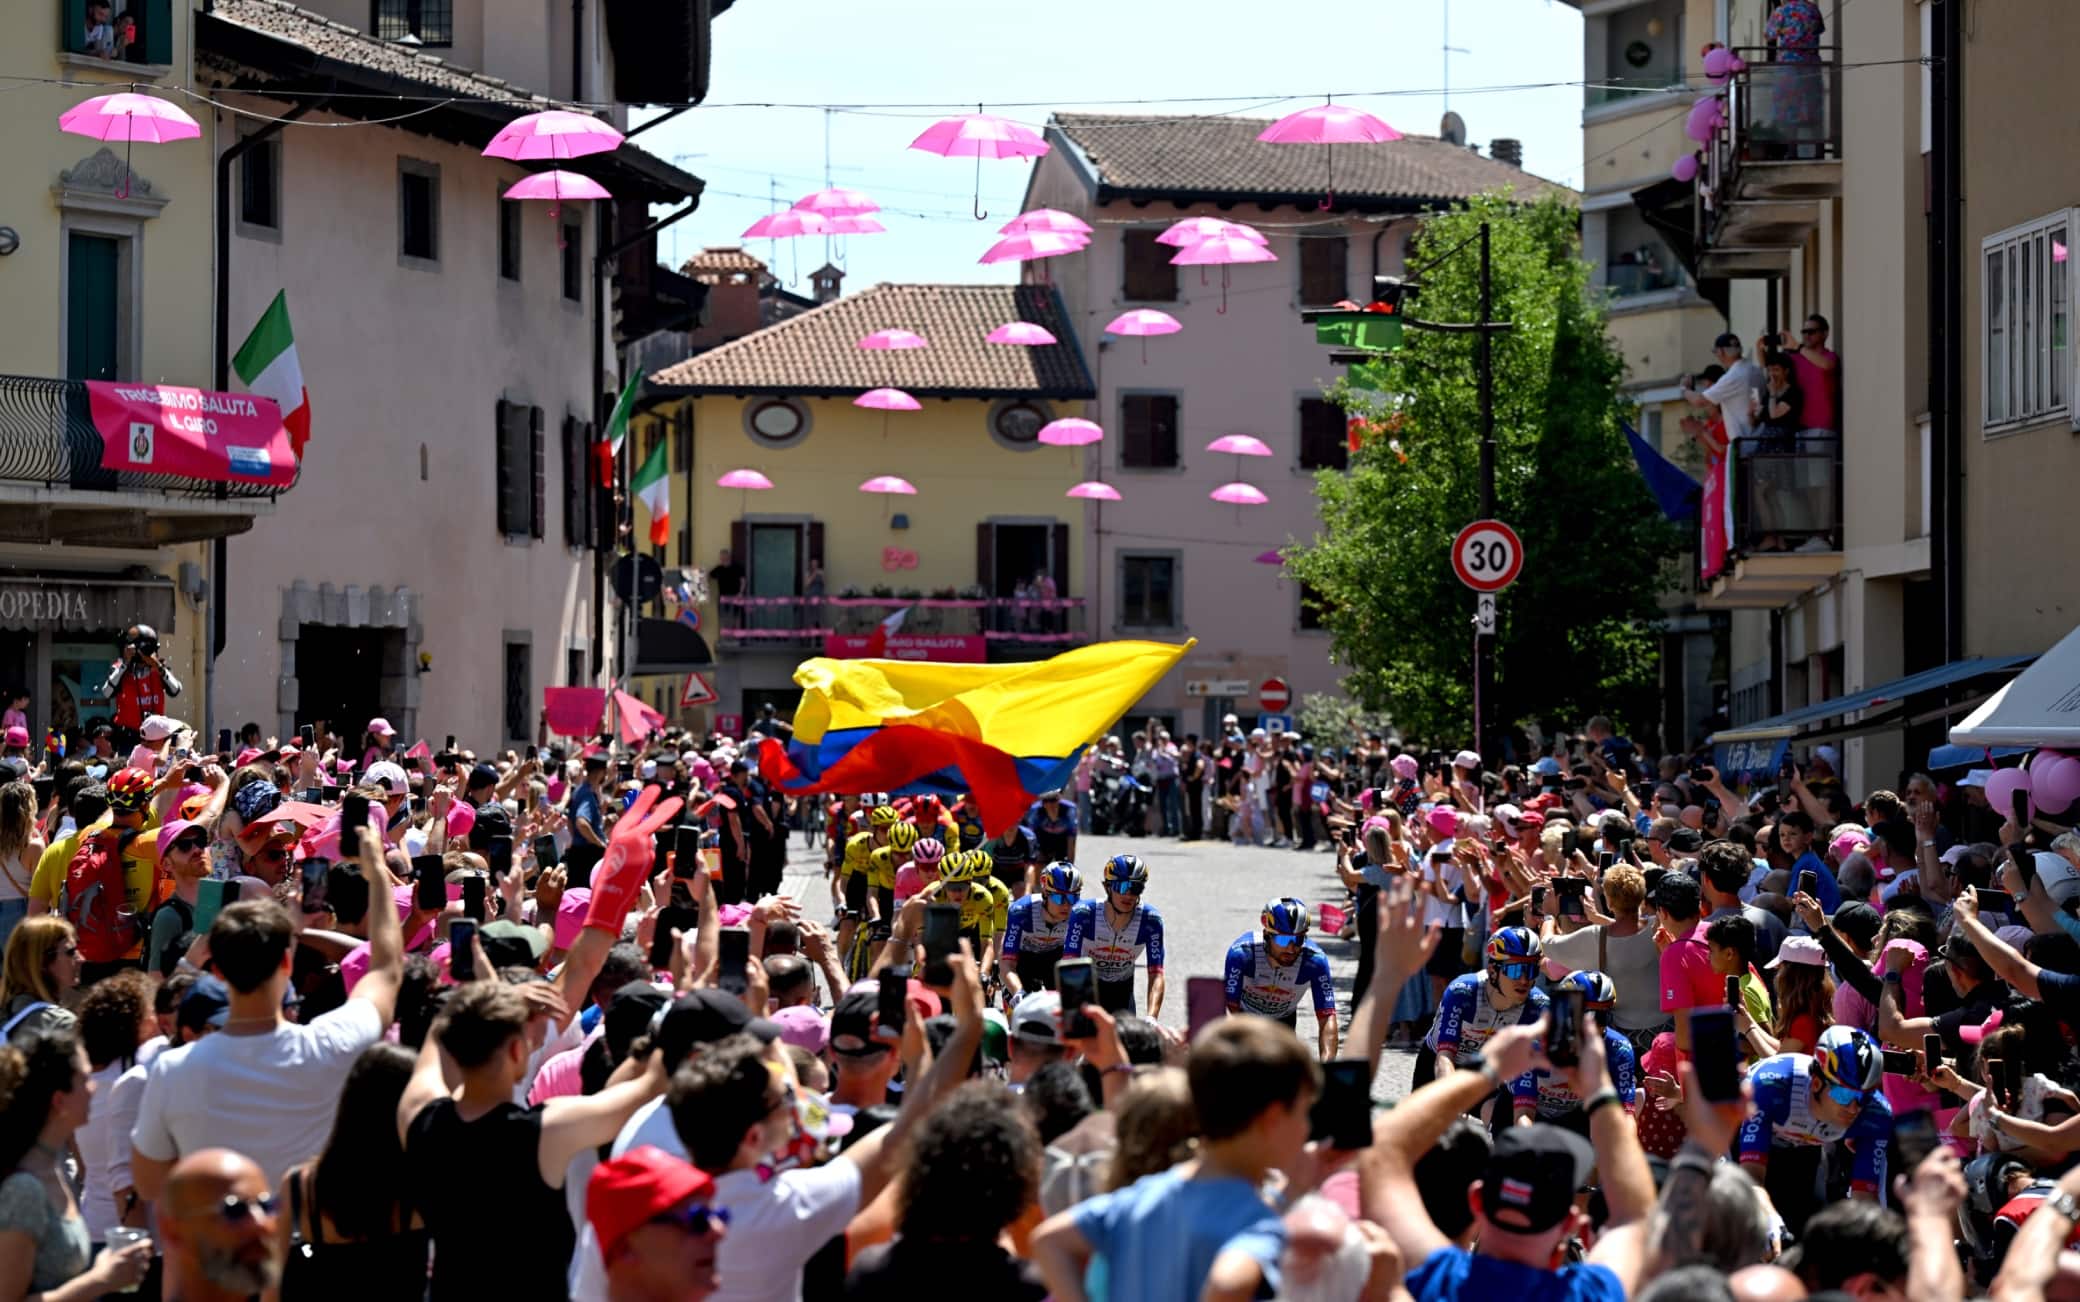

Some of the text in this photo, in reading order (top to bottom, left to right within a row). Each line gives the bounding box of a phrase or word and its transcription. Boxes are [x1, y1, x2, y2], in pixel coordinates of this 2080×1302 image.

[115, 388, 258, 417] TRICESIMO SALUTA
[184, 417, 218, 435] GIRO
[1470, 541, 1507, 572] 30
[0, 590, 88, 621] OPEDIA
[916, 639, 966, 649] SALUTA
[1005, 924, 1021, 949] BOSS
[1069, 923, 1083, 949] BOSS
[1151, 933, 1161, 959] BOSS
[1096, 960, 1133, 968] ORA
[1226, 967, 1242, 994] BOSS
[1318, 975, 1335, 1002] BOSS
[1445, 1006, 1463, 1037] BOSS
[1618, 1063, 1631, 1095] BOSS
[1744, 1110, 1765, 1143] BOSS
[1873, 1139, 1888, 1175] BOSS
